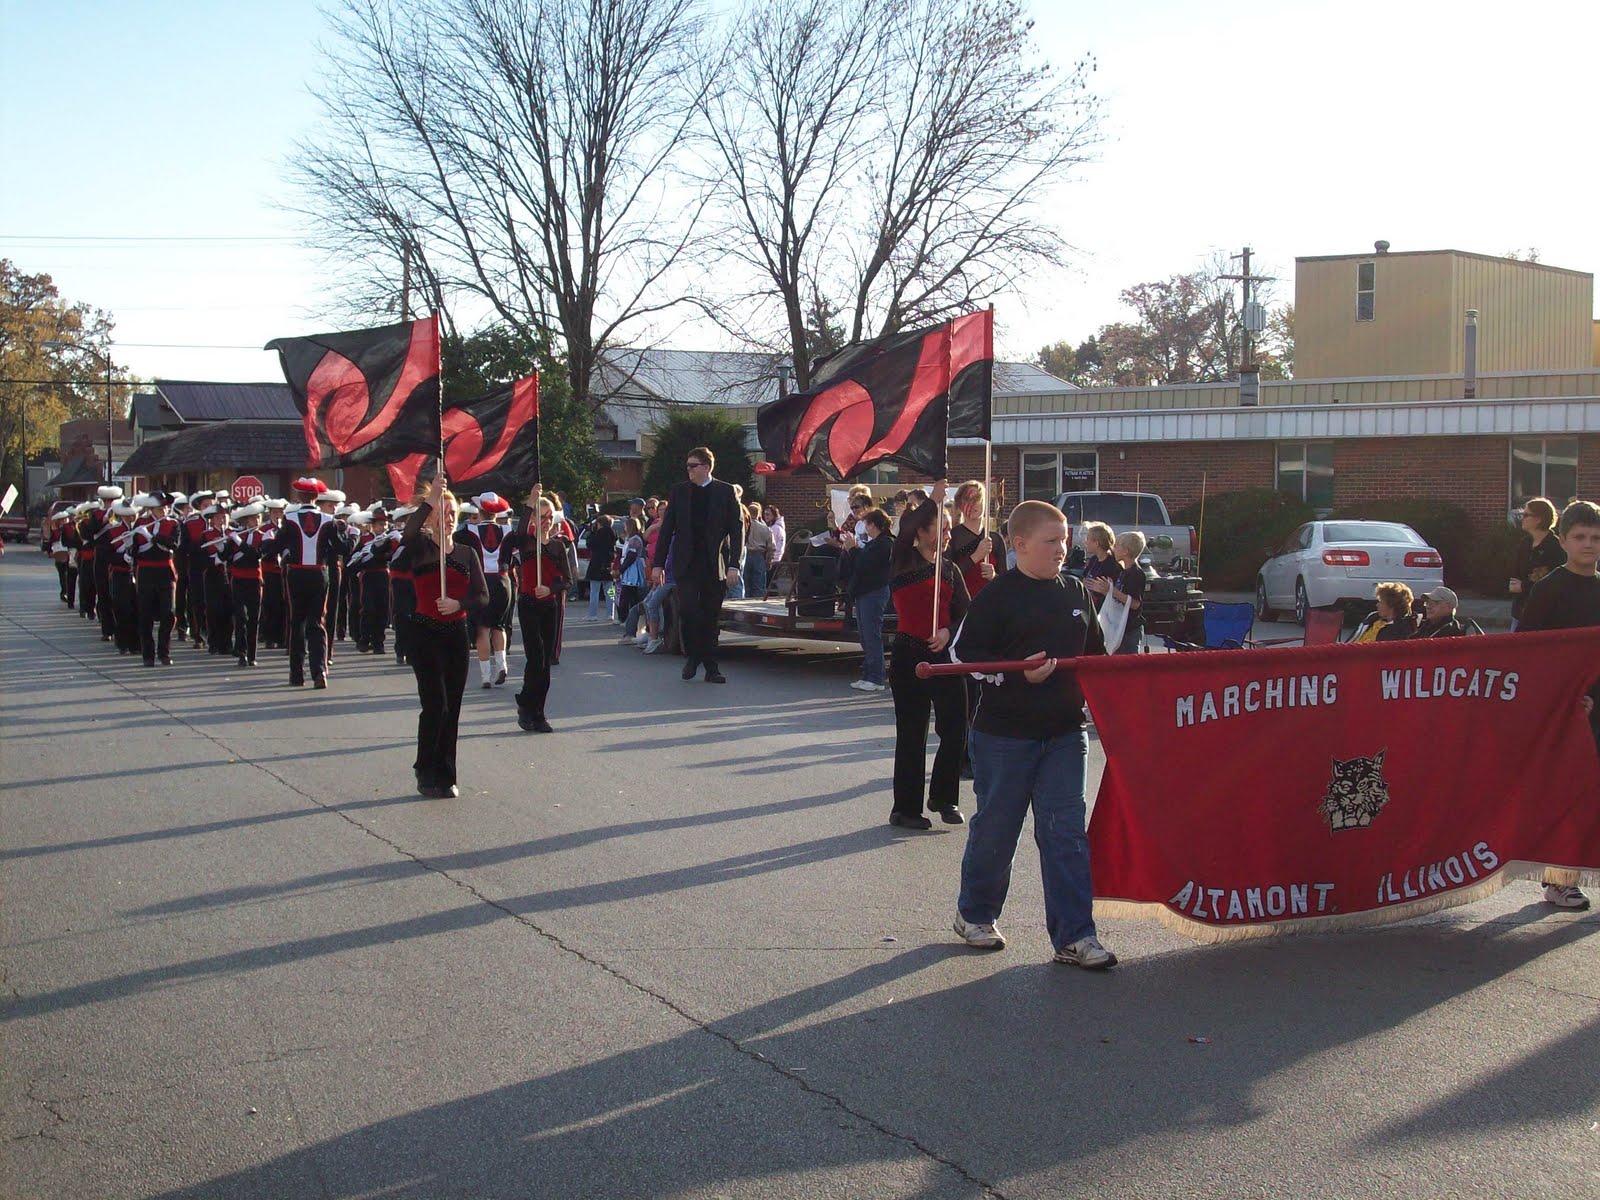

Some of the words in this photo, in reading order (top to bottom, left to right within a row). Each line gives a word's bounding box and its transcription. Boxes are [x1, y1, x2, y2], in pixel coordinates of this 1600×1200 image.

[234, 485, 262, 498] STOP
[1175, 673, 1338, 728] MARCHING
[1381, 667, 1520, 701] WILDCATS
[1377, 841, 1499, 904] ILLINOIS
